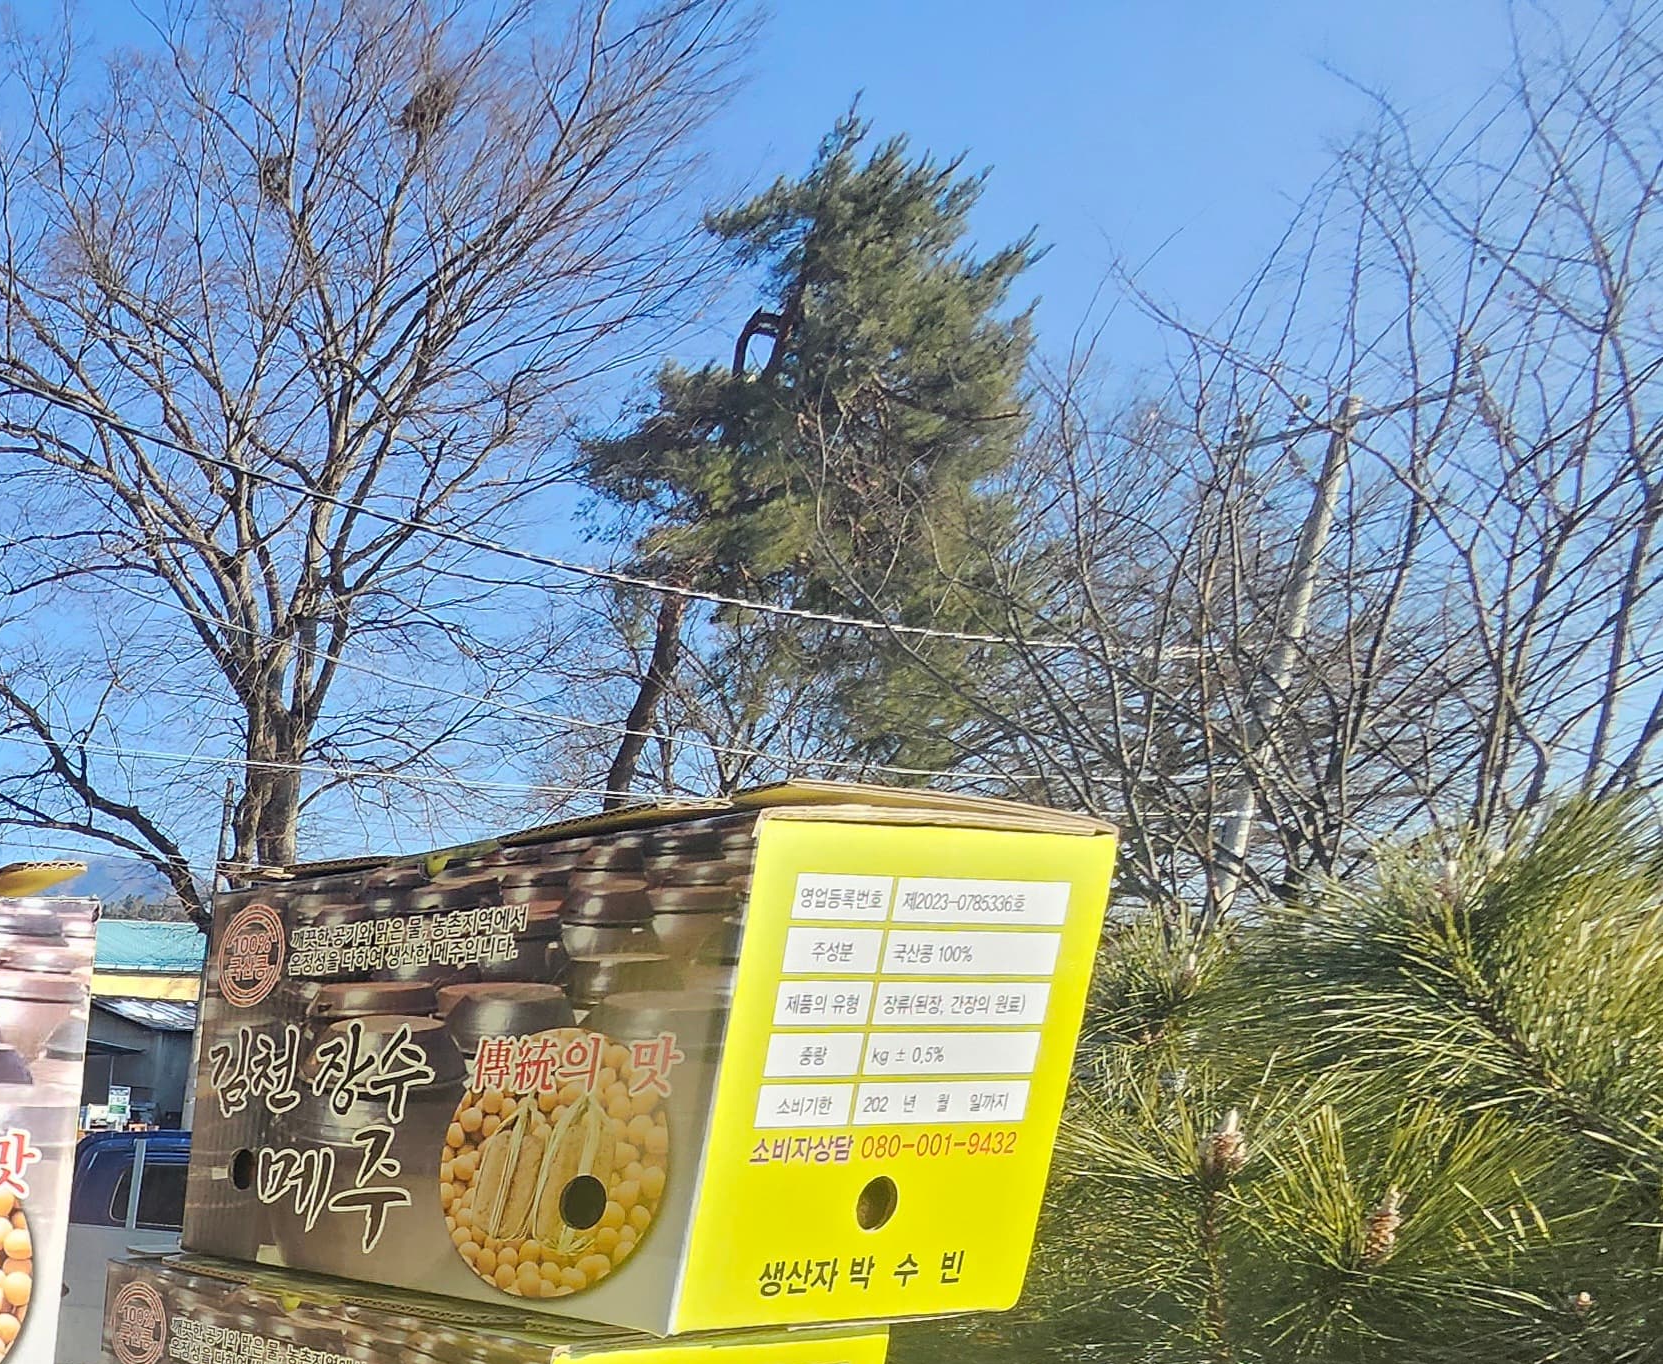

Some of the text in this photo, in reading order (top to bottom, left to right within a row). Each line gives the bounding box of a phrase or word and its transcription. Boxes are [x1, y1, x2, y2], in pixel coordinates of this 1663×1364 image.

[799, 887, 1027, 913] 영업등록번호 제2023-0785336호
[290, 927, 331, 950] 깨끗한
[332, 921, 374, 948] 공기와
[375, 917, 404, 944] 맑은
[431, 903, 529, 938] 농촌지역에서
[232, 932, 273, 956] 100%
[288, 934, 519, 977] 온정성을 다하여 생산한 메주입니다.
[810, 941, 974, 965] 주성분 국산콩 100%
[227, 955, 270, 981] 국산콩
[785, 993, 1027, 1017] 제품의 유형 장류(된장, 간장의 원료)
[471, 1035, 685, 1097] 傳統의 맛
[799, 1045, 828, 1067] 중량
[870, 1046, 890, 1066] kg
[208, 1021, 436, 1124] 김천 장수
[775, 1091, 1010, 1117] 소비기한 202 년 월 일까지
[748, 1131, 1019, 1164] 소비자상담 080-001-9432
[757, 1249, 966, 1298] 생산자 박 수 빈
[170, 1317, 204, 1343] 깨끗한
[204, 1327, 240, 1353] 공기와
[169, 1337, 212, 1364] 온정성을
